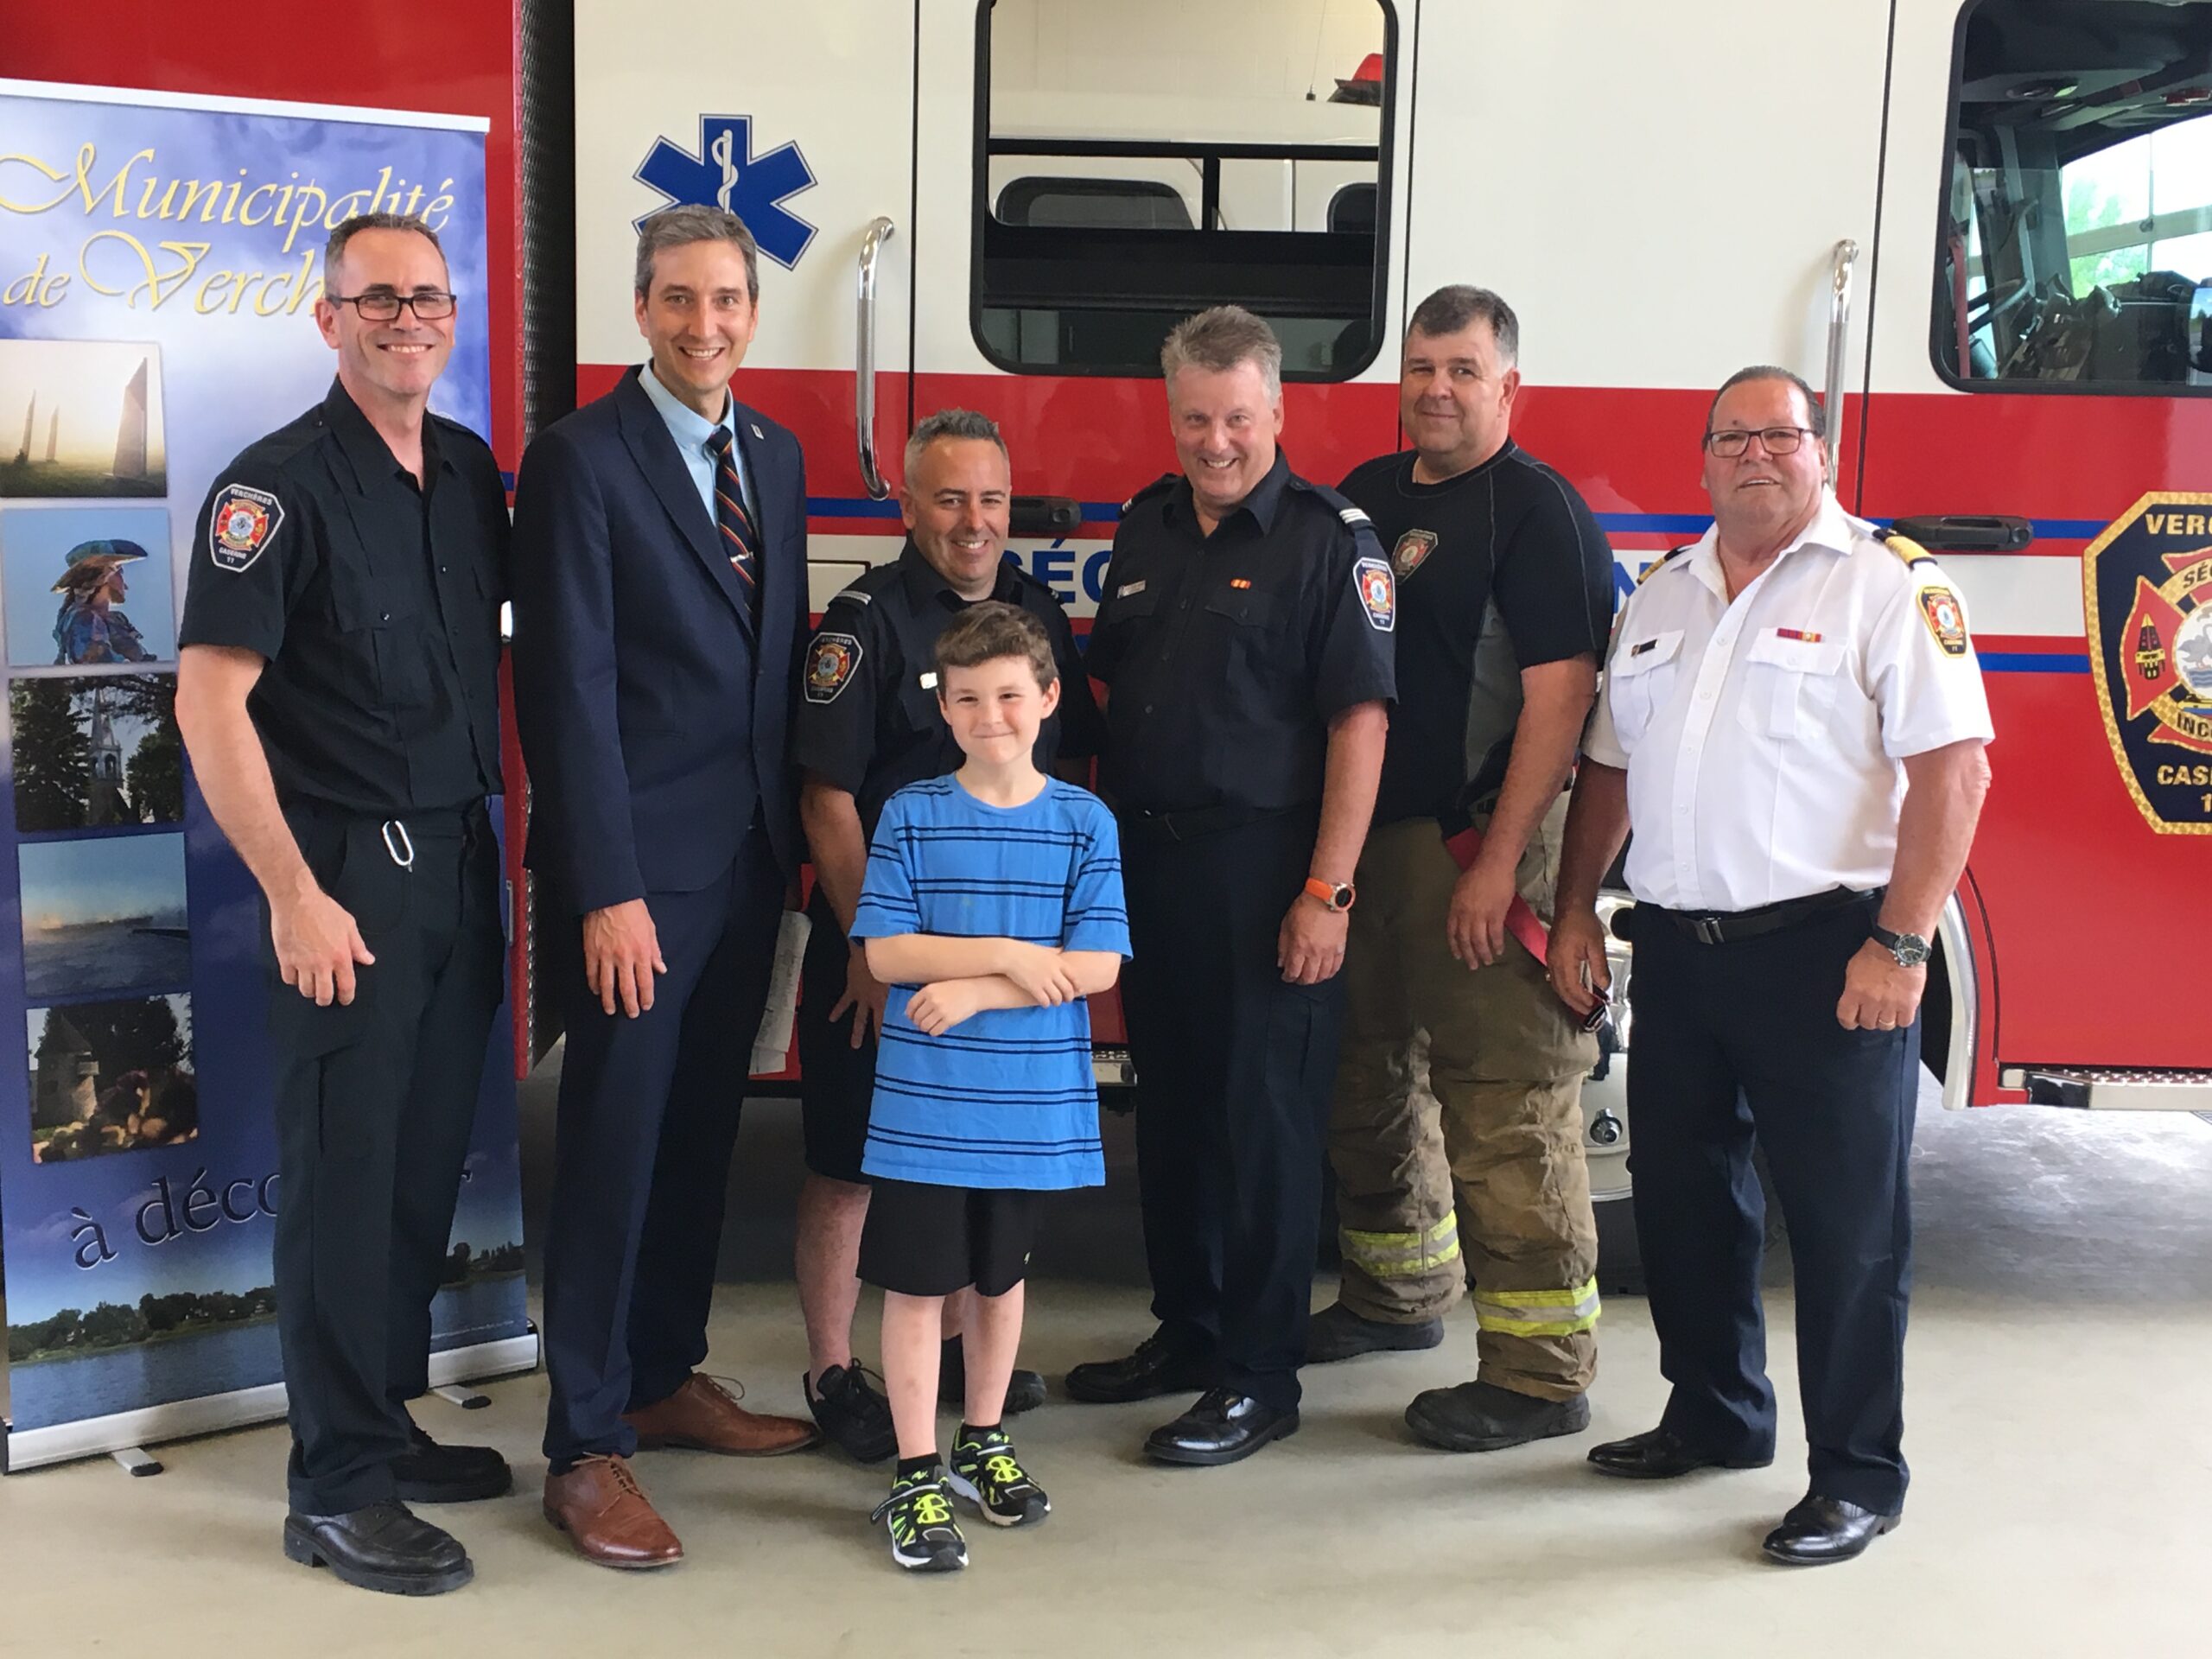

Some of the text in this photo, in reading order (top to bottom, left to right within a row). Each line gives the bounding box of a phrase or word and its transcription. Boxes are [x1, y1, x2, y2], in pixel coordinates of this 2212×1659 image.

[0, 142, 454, 253] Municipalité
[3, 252, 71, 308] de
[2145, 513, 2212, 535] VER
[2183, 562, 2212, 589] SÉ
[2177, 712, 2212, 738] INC
[2158, 765, 2212, 785] CAS
[71, 1206, 118, 1270] à
